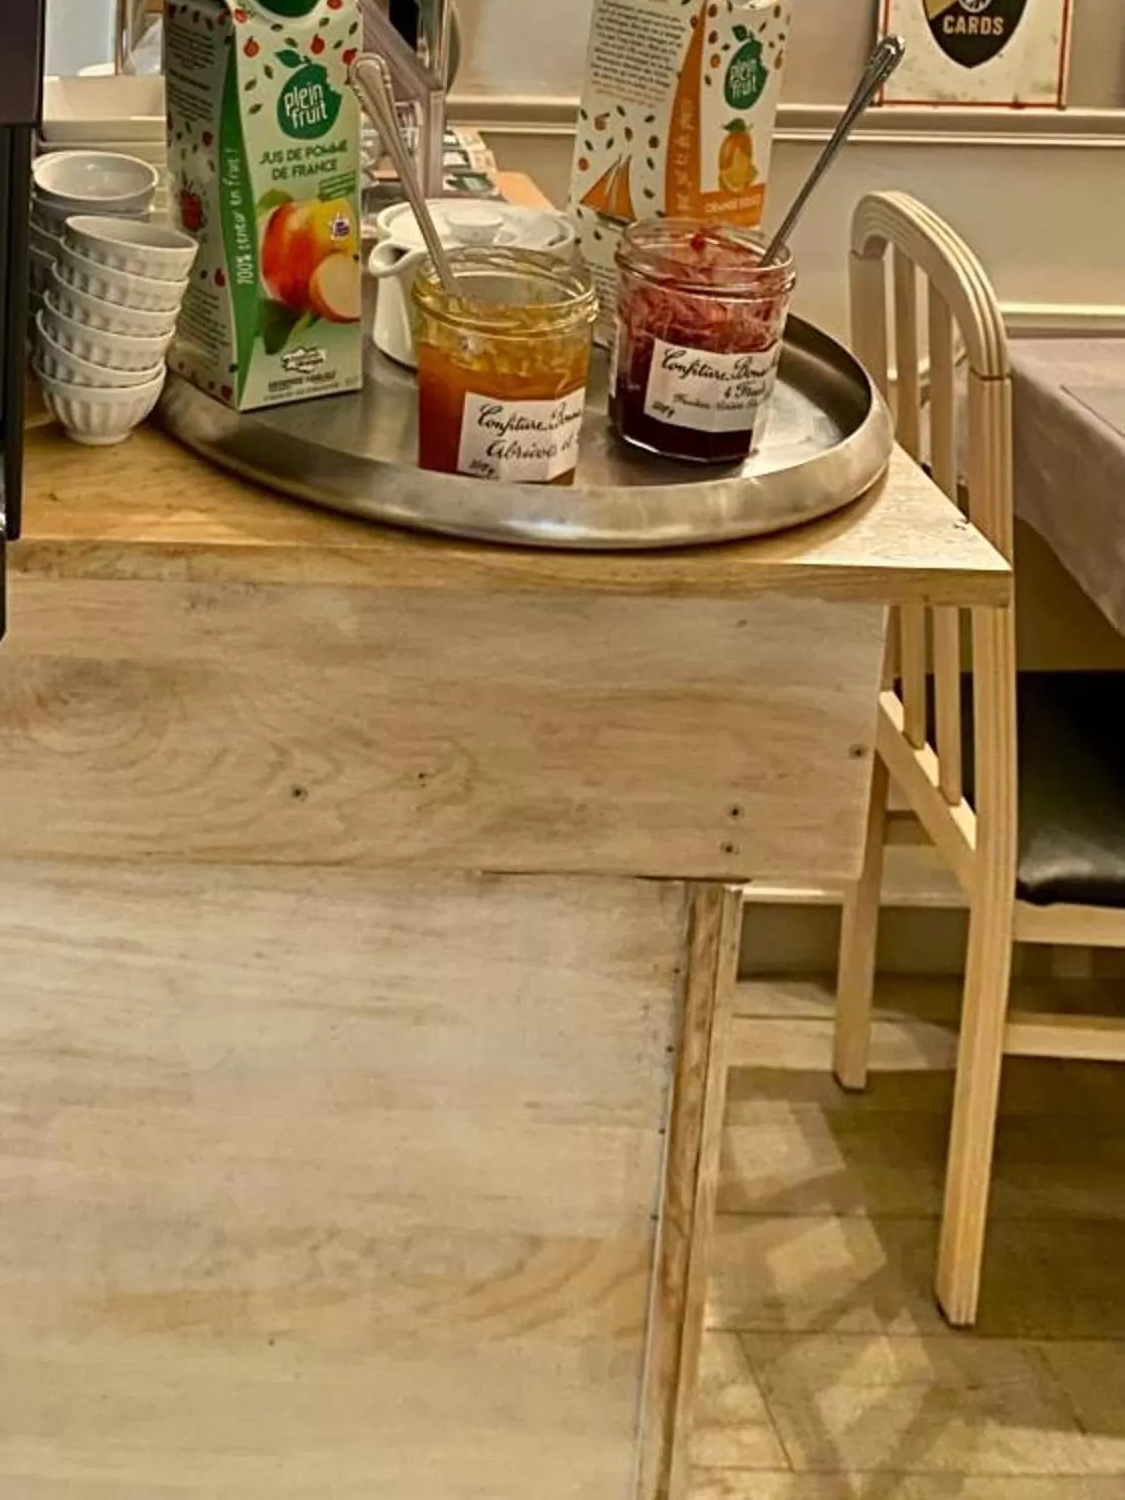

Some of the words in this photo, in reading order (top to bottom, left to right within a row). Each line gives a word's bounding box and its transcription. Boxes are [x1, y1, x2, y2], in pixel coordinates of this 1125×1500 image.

[942, 15, 1004, 36] CARDS
[284, 82, 324, 117] plein
[292, 102, 328, 129] fruit
[259, 149, 284, 165] JUS
[286, 148, 303, 162] DE
[272, 165, 288, 180] DE
[291, 159, 338, 178] FRANCE
[235, 254, 255, 285] 100%
